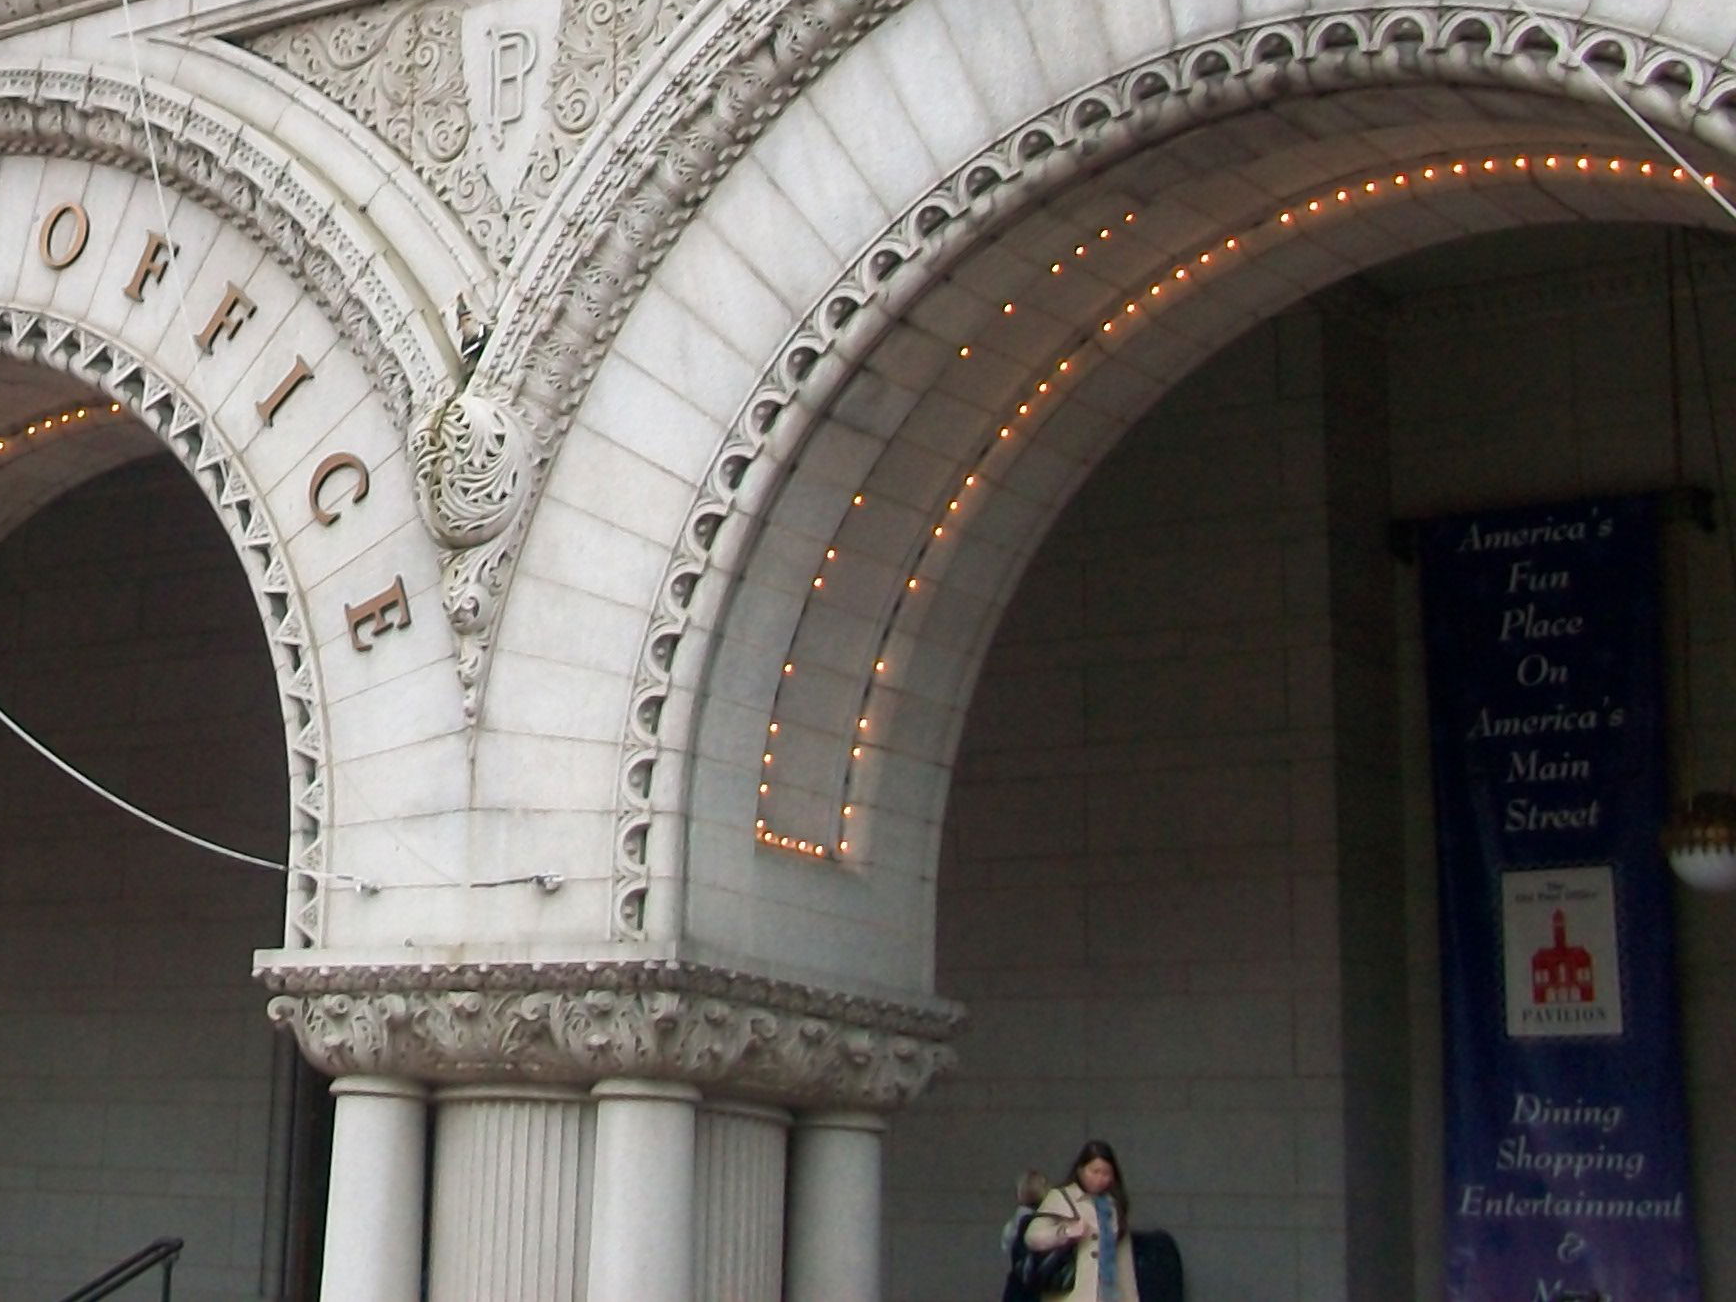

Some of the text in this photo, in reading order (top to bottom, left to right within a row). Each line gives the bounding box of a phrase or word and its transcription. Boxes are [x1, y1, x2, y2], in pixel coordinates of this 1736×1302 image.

[37, 201, 413, 653] OFFICE
[1458, 506, 1615, 553] America's
[1506, 561, 1570, 595] Fun
[1498, 603, 1585, 643] Place
[1516, 654, 1569, 687] On
[1466, 696, 1625, 740] America's
[1505, 751, 1591, 784] Main
[1503, 797, 1600, 833] Street
[1520, 1007, 1608, 1024] PAVILION
[1512, 1092, 1624, 1133] Dining
[1495, 1135, 1646, 1179] Shopping
[1457, 1184, 1685, 1218] Entertainment
[1557, 1230, 1586, 1264] &
